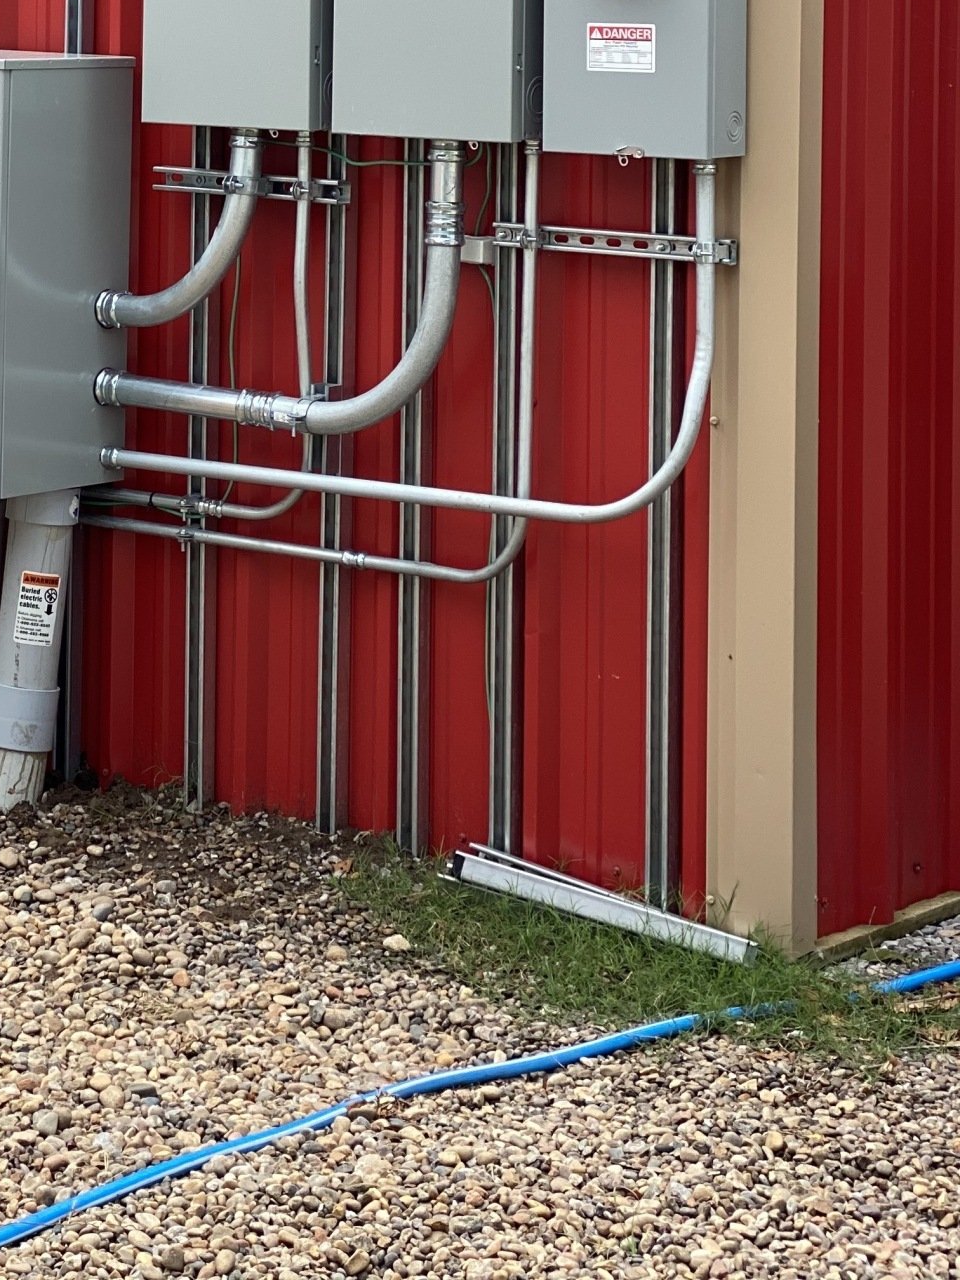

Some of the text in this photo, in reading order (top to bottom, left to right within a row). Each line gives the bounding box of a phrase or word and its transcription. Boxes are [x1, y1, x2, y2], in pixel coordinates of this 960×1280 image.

[602, 28, 651, 39] DANGER
[21, 586, 41, 595] Buried
[20, 594, 42, 602] electric
[19, 601, 40, 610] cables.
